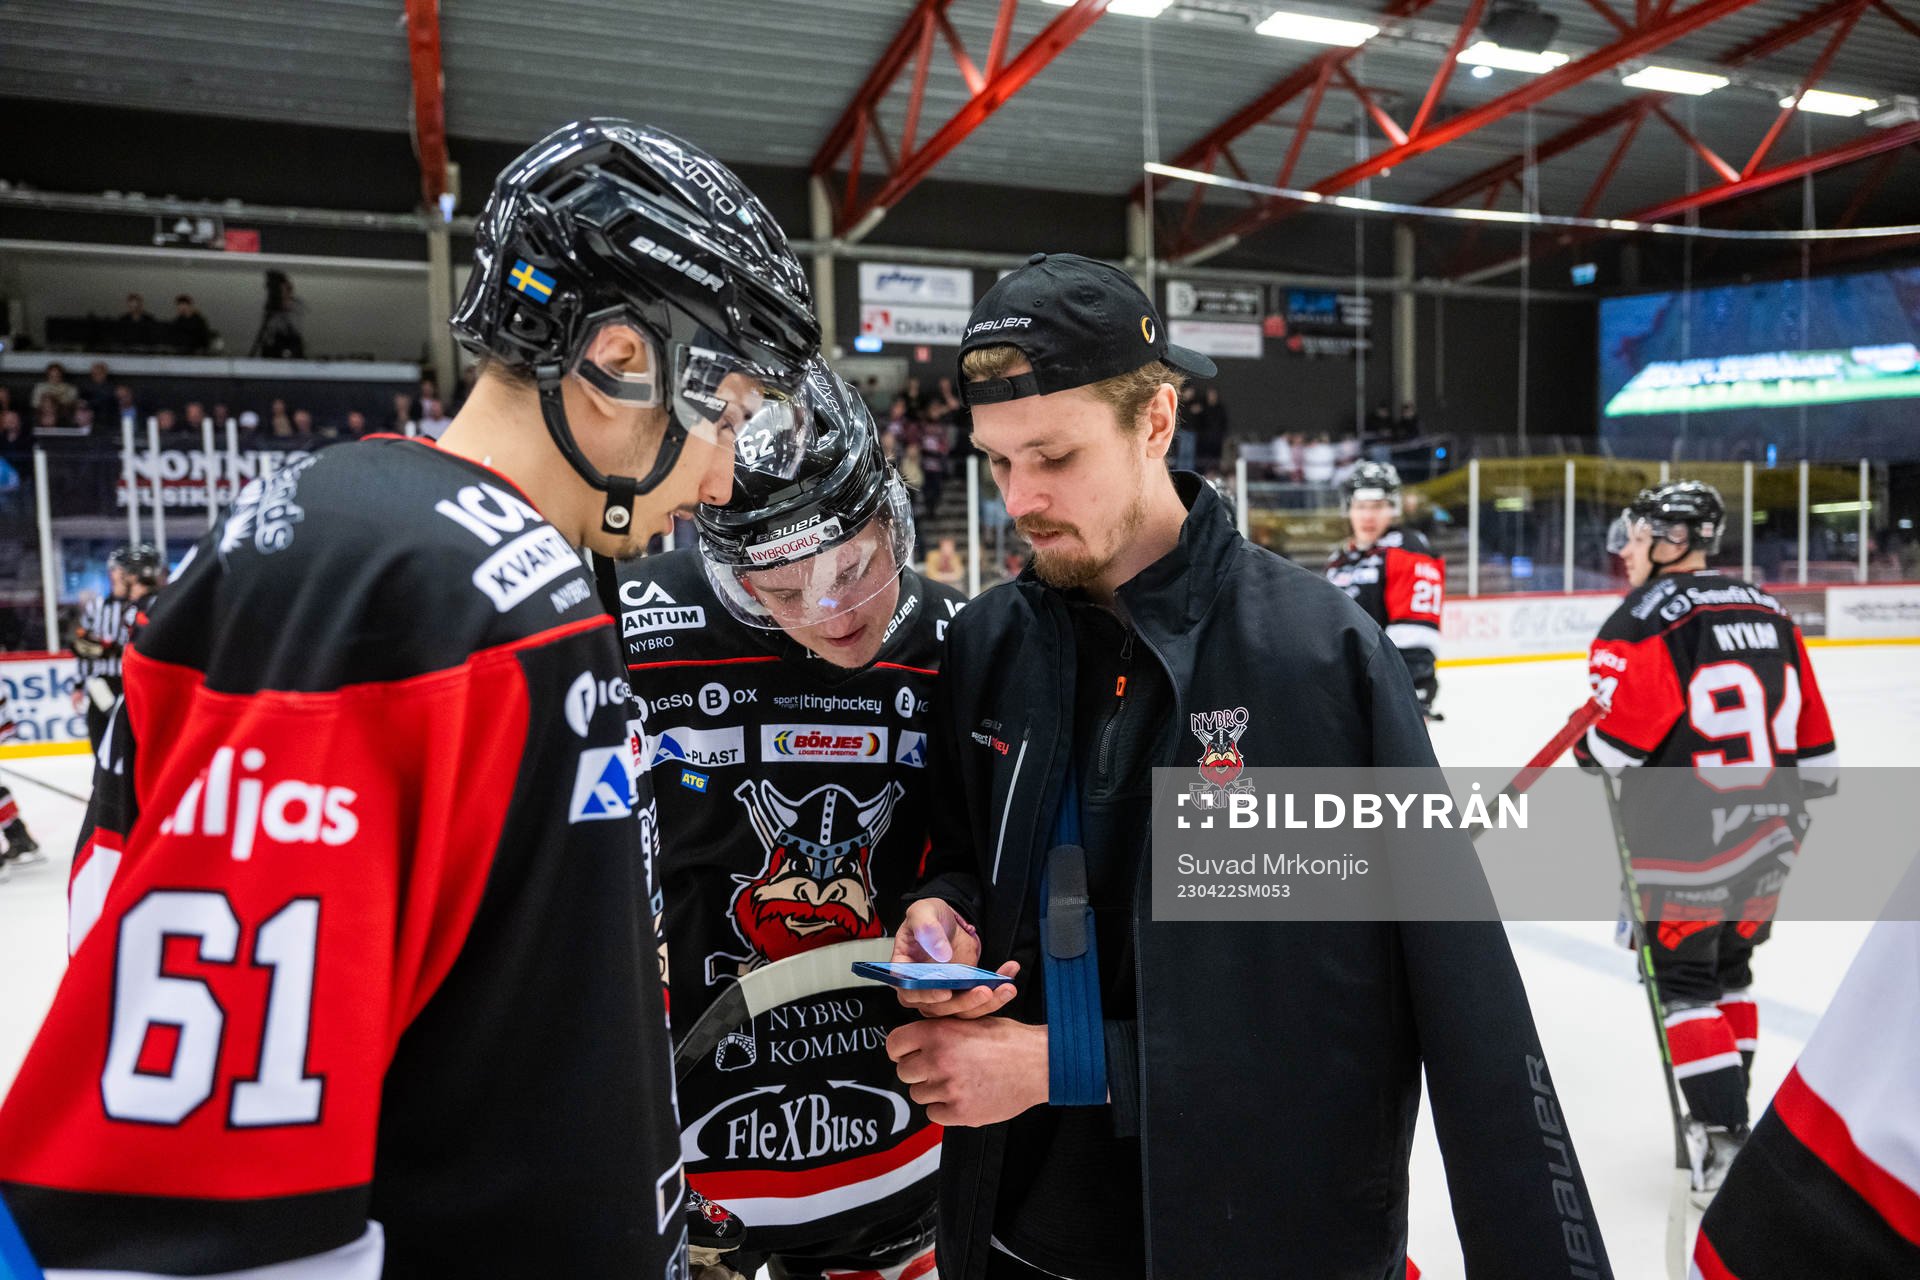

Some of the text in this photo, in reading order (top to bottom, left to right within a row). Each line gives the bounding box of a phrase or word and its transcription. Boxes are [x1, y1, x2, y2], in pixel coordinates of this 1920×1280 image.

[629, 235, 725, 293] BAUER
[972, 316, 1033, 334] BAUER
[737, 428, 775, 466] 62
[434, 482, 544, 547] ICA
[751, 532, 821, 563] NYBROGRUS
[619, 580, 677, 606] CA
[1410, 579, 1442, 616] 21
[624, 610, 700, 632] ANTUM
[629, 636, 674, 655] NYBRO
[640, 693, 693, 722] IGSO
[804, 693, 882, 714] tinghockey
[1190, 706, 1249, 732] NYBRO
[794, 731, 864, 749] BÖRJES
[681, 773, 705, 788] ATG
[161, 747, 359, 861] iljas
[101, 889, 326, 1131] 61
[769, 998, 863, 1031] NYBRO
[725, 1094, 878, 1161] FleXBuss
[1525, 1054, 1597, 1265] BAUER
